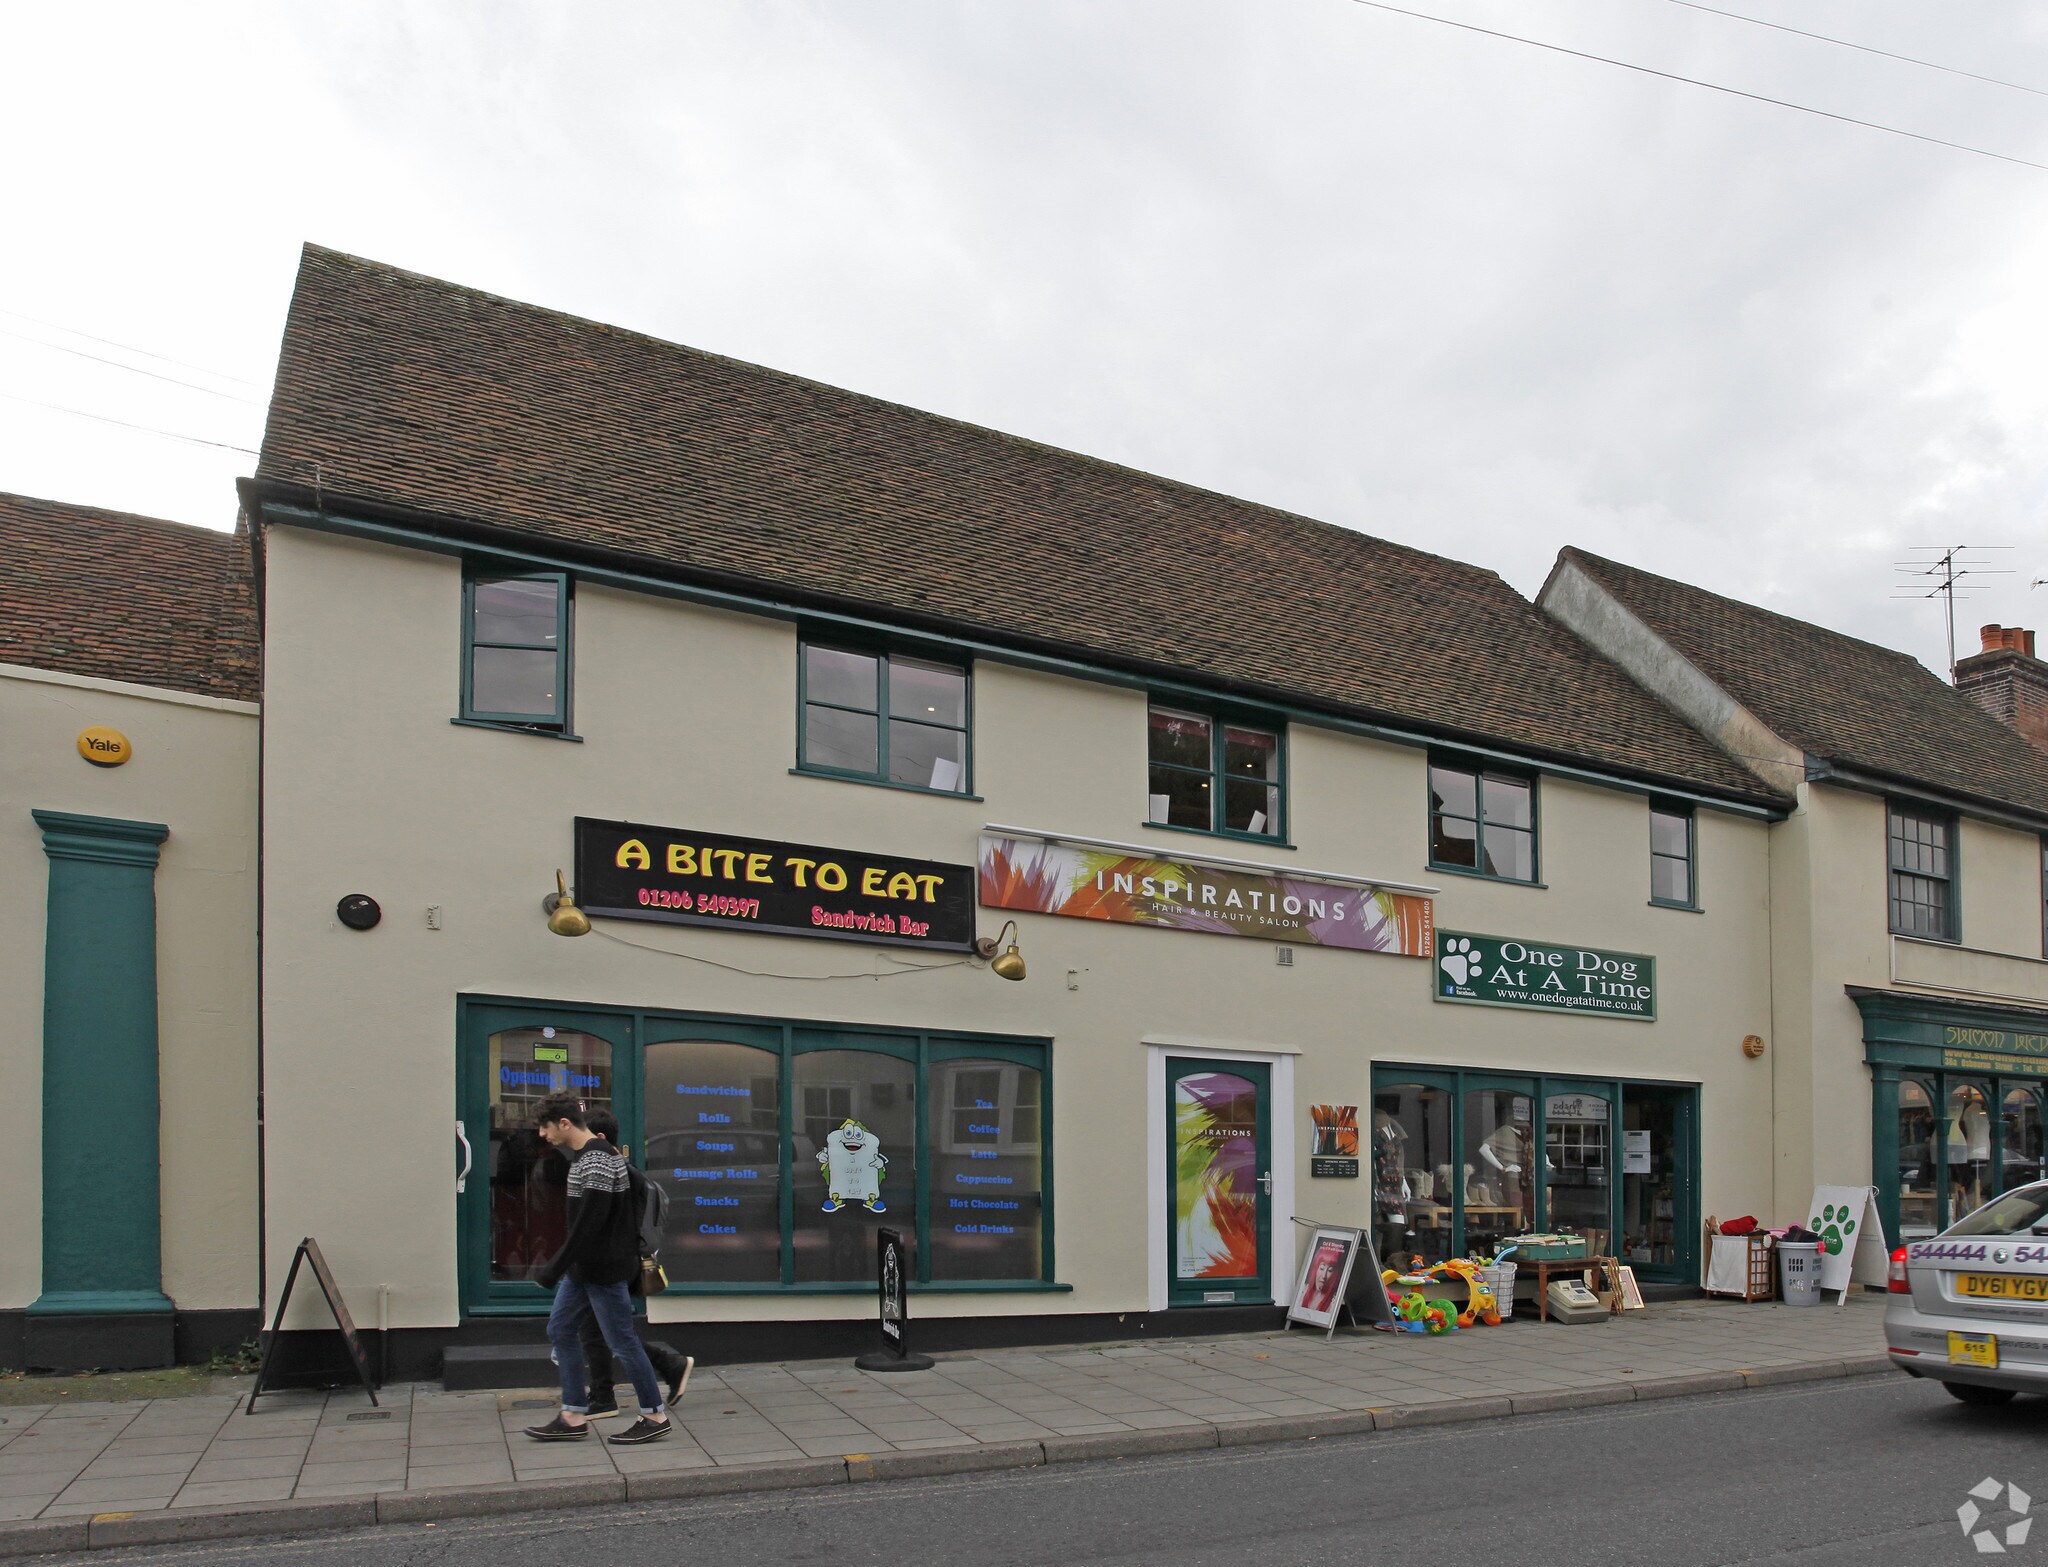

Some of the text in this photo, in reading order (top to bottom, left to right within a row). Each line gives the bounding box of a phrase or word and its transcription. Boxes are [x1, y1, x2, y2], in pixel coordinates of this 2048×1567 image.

[86, 737, 121, 753] Yale
[615, 838, 945, 903] A BITE TO EAT
[1096, 869, 1346, 922] INSPIRATIONS
[638, 887, 760, 919] 01206 549397
[811, 905, 930, 937] Sandwich Bar
[1152, 902, 1300, 929] HAIR & BEAUTY SALON
[1423, 899, 1431, 956] 01206 541400
[1499, 942, 1638, 981] One Dog
[1488, 964, 1652, 1000] At A Time
[1496, 988, 1644, 1012] www.onedogatatime.co.uk
[1946, 1026, 2005, 1048] SWOON
[499, 1065, 600, 1089] Opening Times
[675, 1084, 751, 1097] Sandwiches
[975, 1099, 994, 1109] Tea
[698, 1112, 731, 1124] Rolls
[968, 1124, 1001, 1134] Coffee
[1180, 1128, 1251, 1137] INSPIRATIONS
[696, 1140, 735, 1153] Soups
[970, 1149, 998, 1160] Latte
[673, 1168, 758, 1181] Sausage Rolls
[955, 1174, 1013, 1186] Cappuccino
[694, 1196, 740, 1207] Snacks
[949, 1199, 1020, 1210] Hot Chocolate
[699, 1223, 737, 1234] Cakes
[954, 1224, 1014, 1234] Cold Drinks
[1822, 1235, 1838, 1245] Time
[1910, 1244, 2048, 1263] 544444 54
[1967, 1276, 2048, 1296] DY61 YGV
[1964, 1343, 1987, 1353] 615
